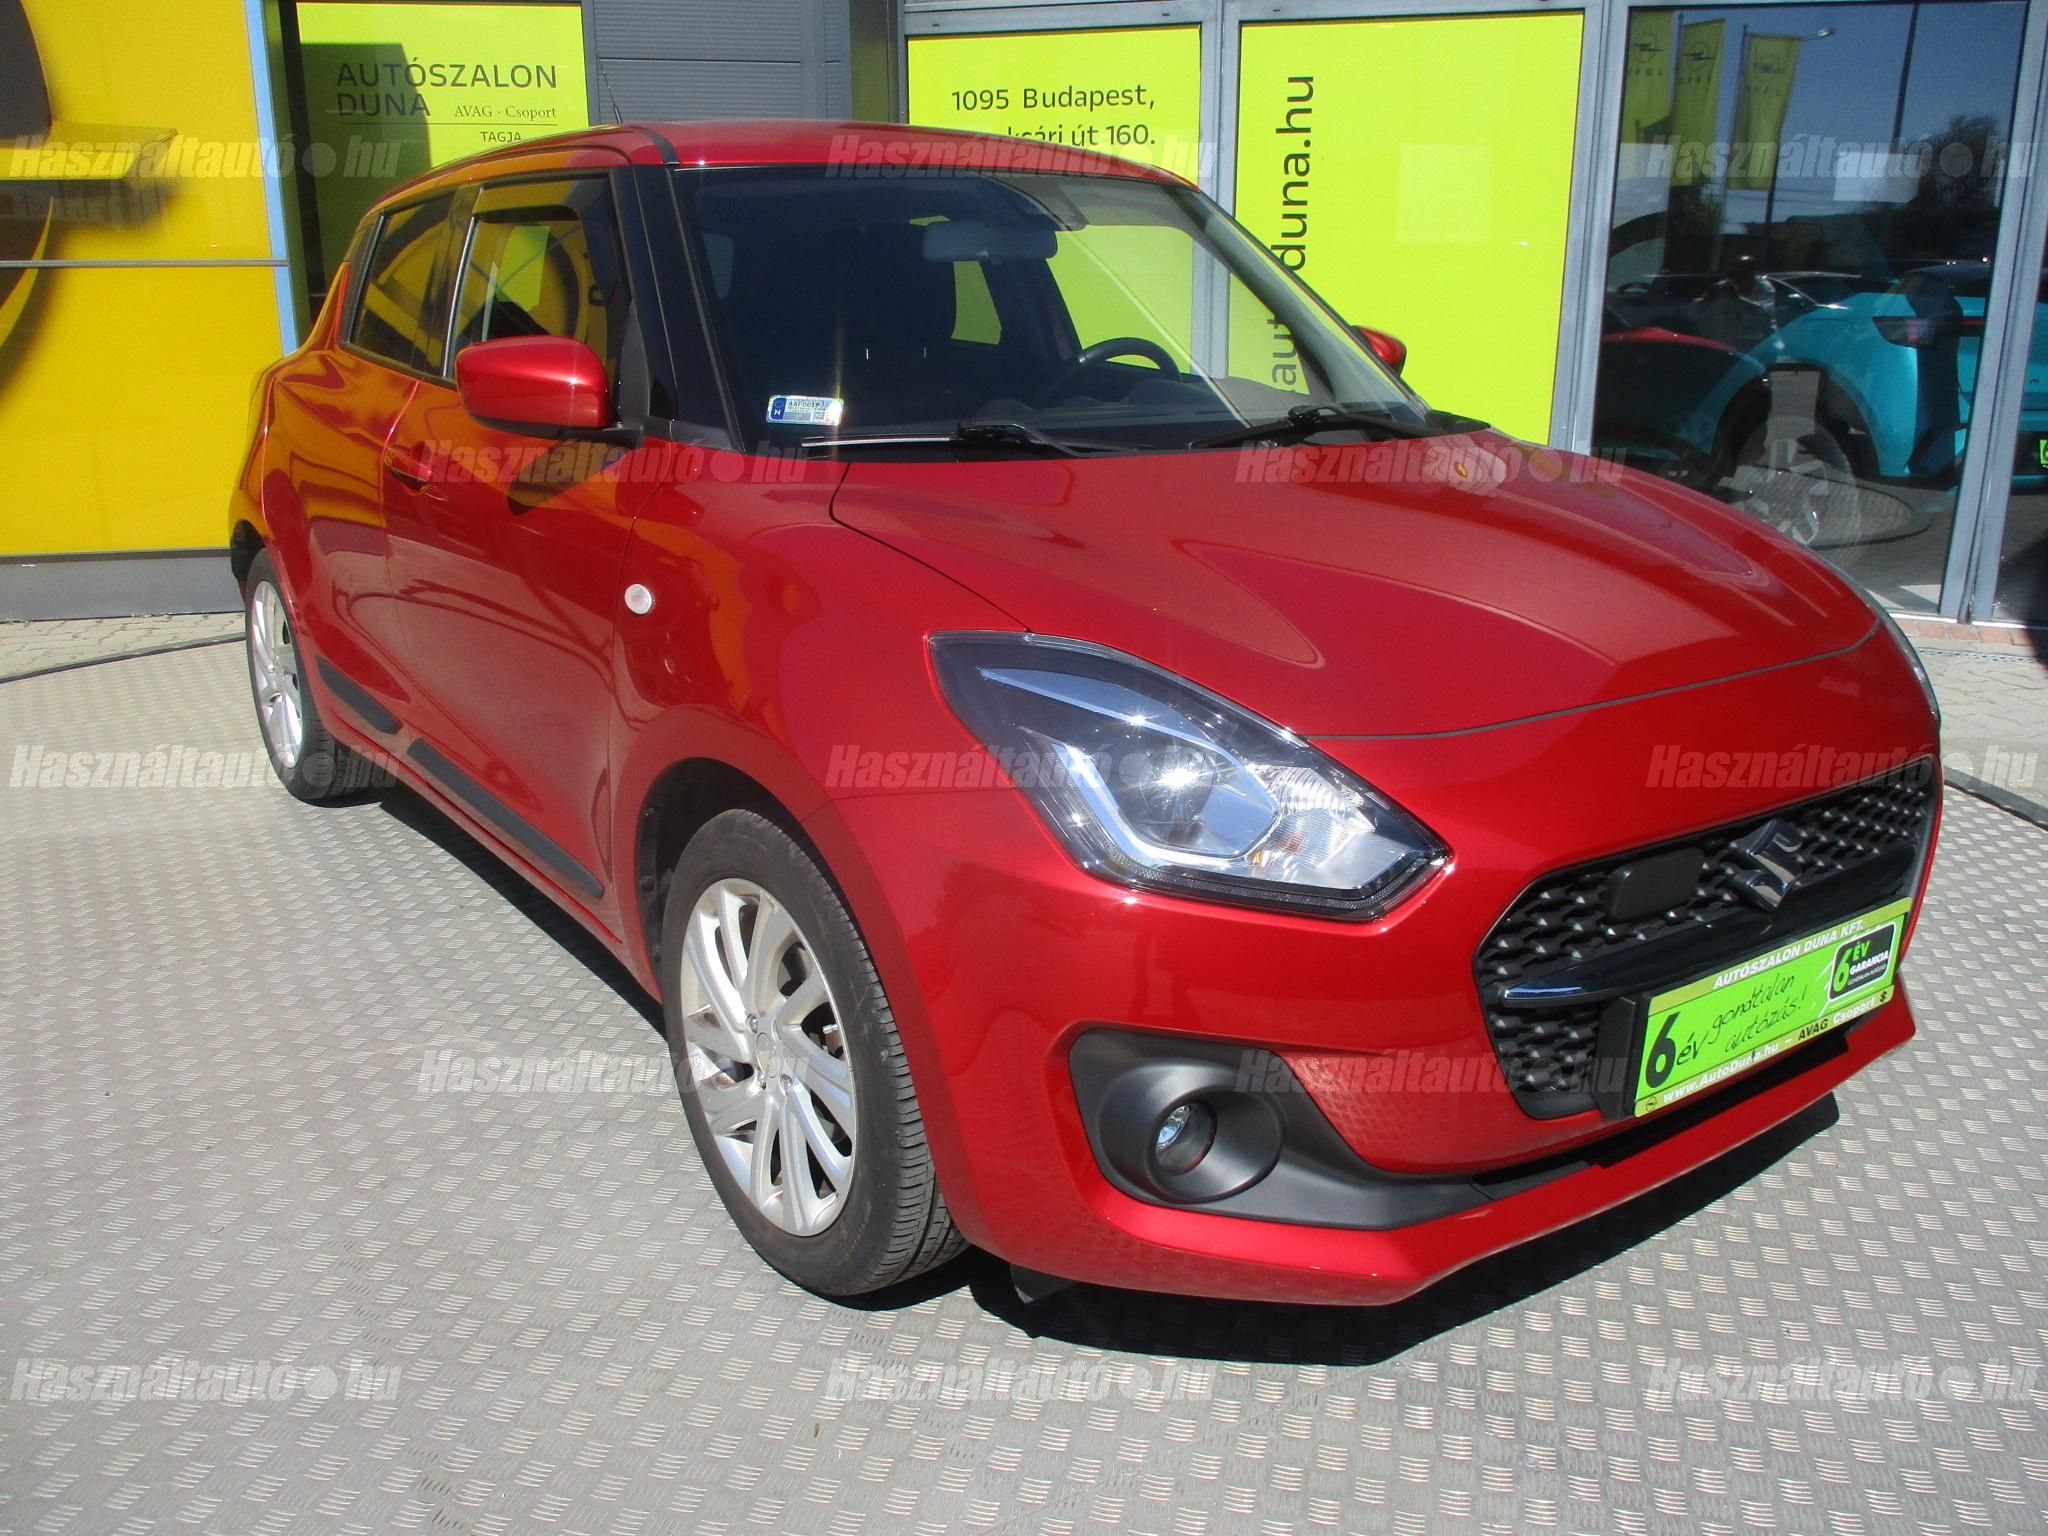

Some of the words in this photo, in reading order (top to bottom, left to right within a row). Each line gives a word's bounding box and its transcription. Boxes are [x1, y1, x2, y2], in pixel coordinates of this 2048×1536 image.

[337, 57, 557, 88] AUTÓSZALON
[338, 92, 430, 117] DUNA
[952, 89, 1009, 111] 1095
[1023, 84, 1155, 112] Budapest,
[454, 105, 493, 118] AVAG
[505, 105, 556, 121] Csoport
[480, 131, 522, 143] TAGJA
[1071, 124, 1099, 147] út
[1106, 124, 1155, 145] 160.
[1713, 943, 1800, 989] AUTÓSZALON
[1803, 930, 1837, 953] DUNA
[1841, 919, 1864, 938] KFT.
[1833, 947, 1854, 992] 6
[1852, 940, 1871, 961] ÉV
[1849, 950, 1889, 975] GARANCIA
[1798, 1018, 1829, 1041] AVAG
[1833, 996, 1876, 1024] Csoport
[1645, 1012, 1681, 1088] 6
[1676, 1032, 1706, 1067] év
